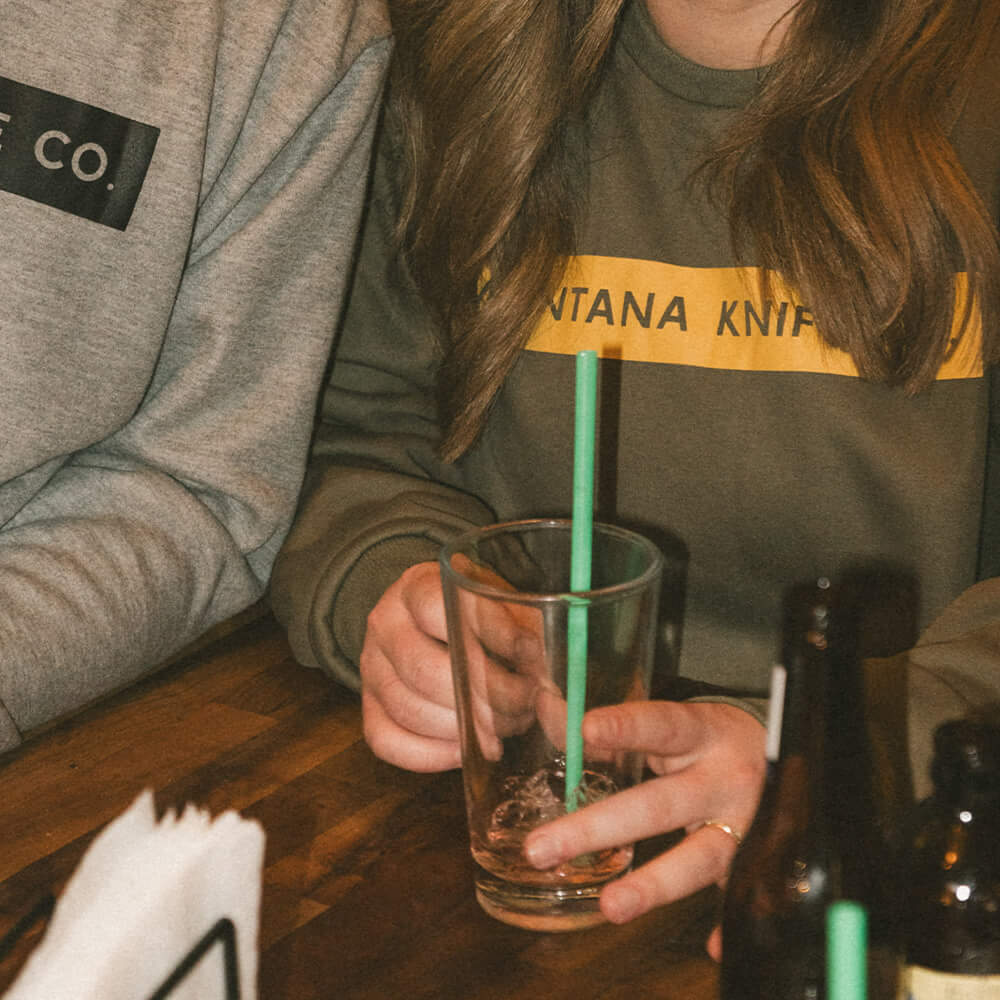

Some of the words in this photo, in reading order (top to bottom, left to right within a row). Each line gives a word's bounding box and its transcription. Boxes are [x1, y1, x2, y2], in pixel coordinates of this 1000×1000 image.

[33, 129, 115, 191] CO.
[549, 286, 688, 332] NTANA
[716, 299, 815, 337] KNIF
